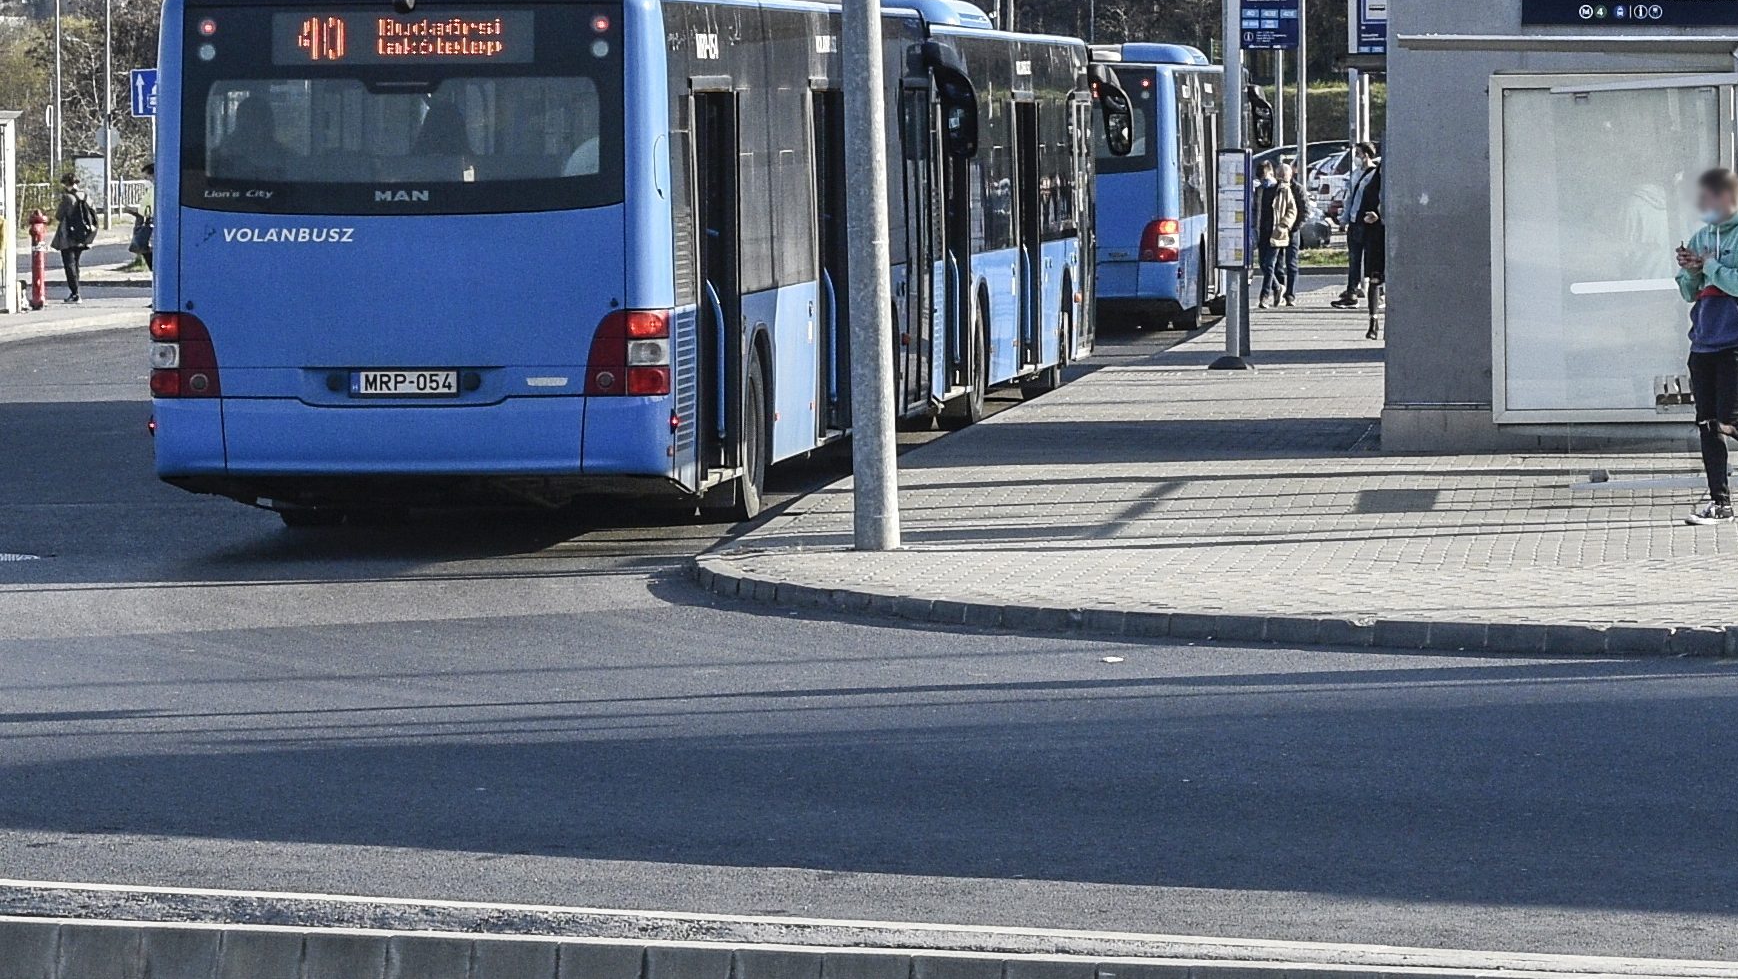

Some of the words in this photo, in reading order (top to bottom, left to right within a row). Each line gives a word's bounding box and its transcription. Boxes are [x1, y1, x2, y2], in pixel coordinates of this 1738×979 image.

[378, 18, 501, 36] Budaörsi
[298, 17, 345, 60] 40
[246, 190, 274, 199] City
[374, 190, 429, 202] MAN
[364, 373, 453, 392] MRP-054
